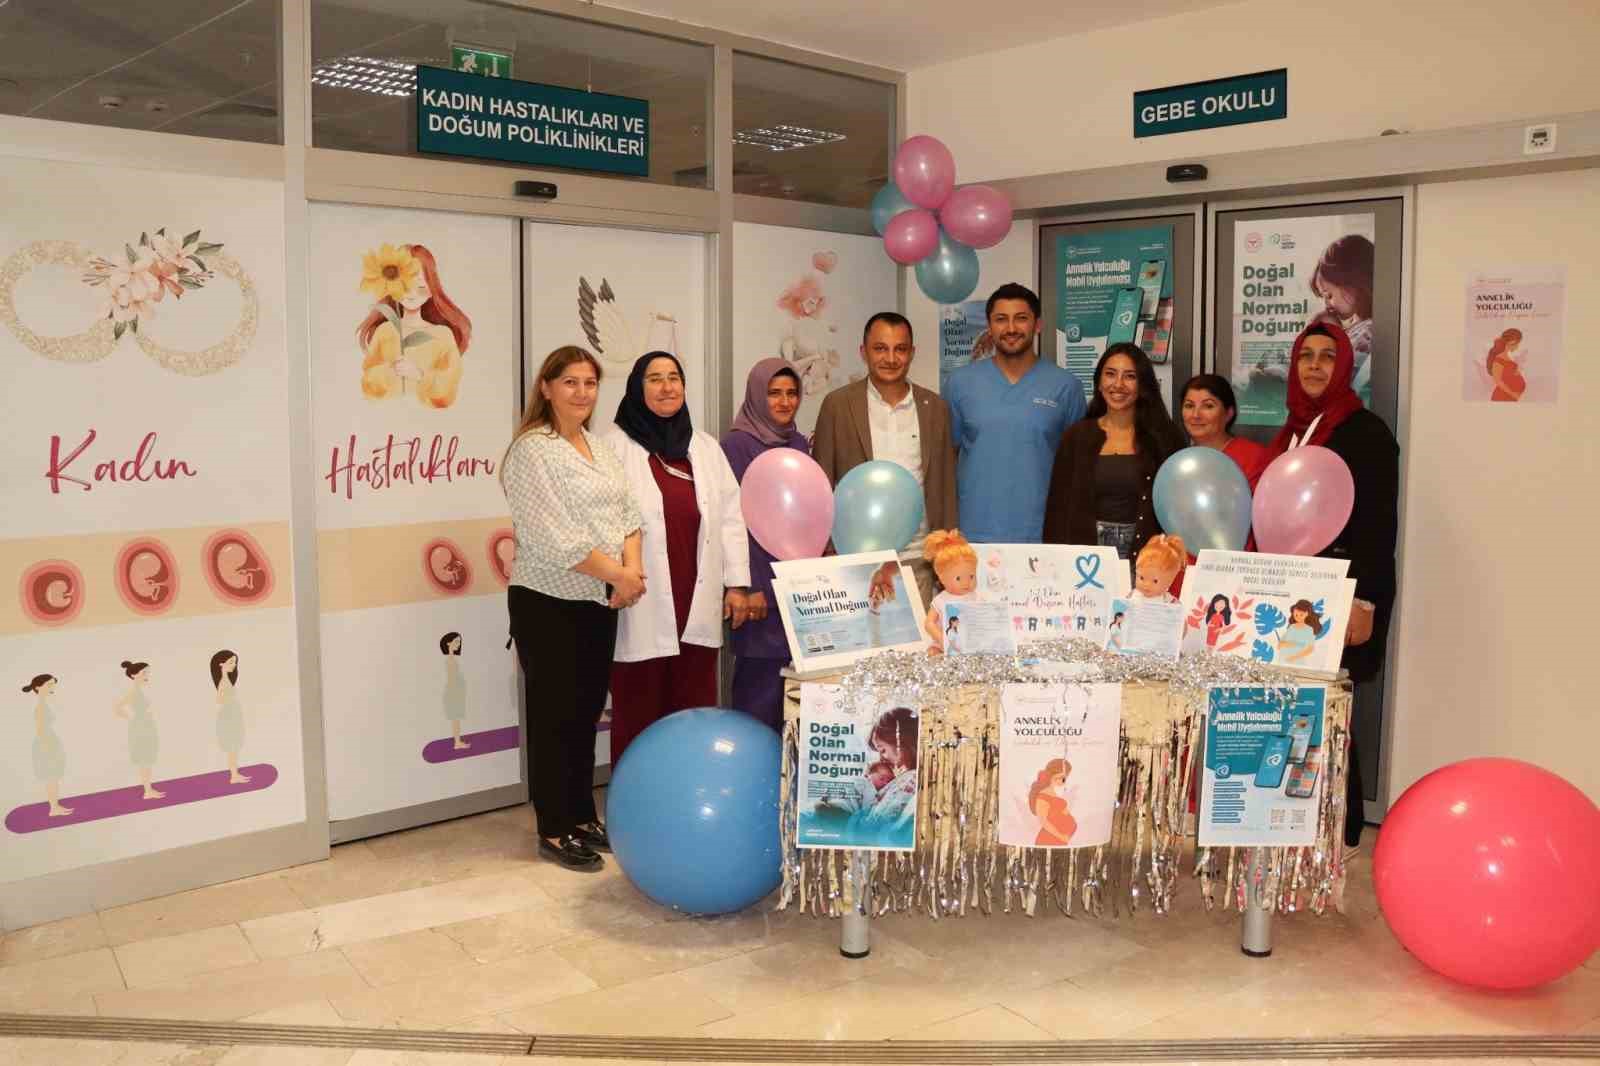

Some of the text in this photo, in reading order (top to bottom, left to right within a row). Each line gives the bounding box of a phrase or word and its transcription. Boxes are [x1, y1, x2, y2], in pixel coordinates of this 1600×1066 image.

[423, 88, 644, 135] KADIN HASTALIKLARI VE
[1141, 88, 1275, 124] GEBE OKULU
[429, 114, 644, 157] DOĞUM POLİKLİNİKLERİ
[1243, 263, 1294, 282] Doğal
[1243, 284, 1284, 297] Olan
[1242, 299, 1308, 315] Normal
[1242, 318, 1306, 336] Doğum
[45, 429, 197, 494] Kadın
[325, 434, 495, 499] Hastalıkları
[792, 588, 847, 604] Doğal Olan
[795, 600, 869, 616] Normal Doğum
[810, 722, 854, 737] Doğal
[1014, 726, 1082, 736] YOLCULUĞU
[809, 737, 846, 748] Olan
[809, 750, 866, 762] Normal
[808, 763, 863, 778] Doğum
